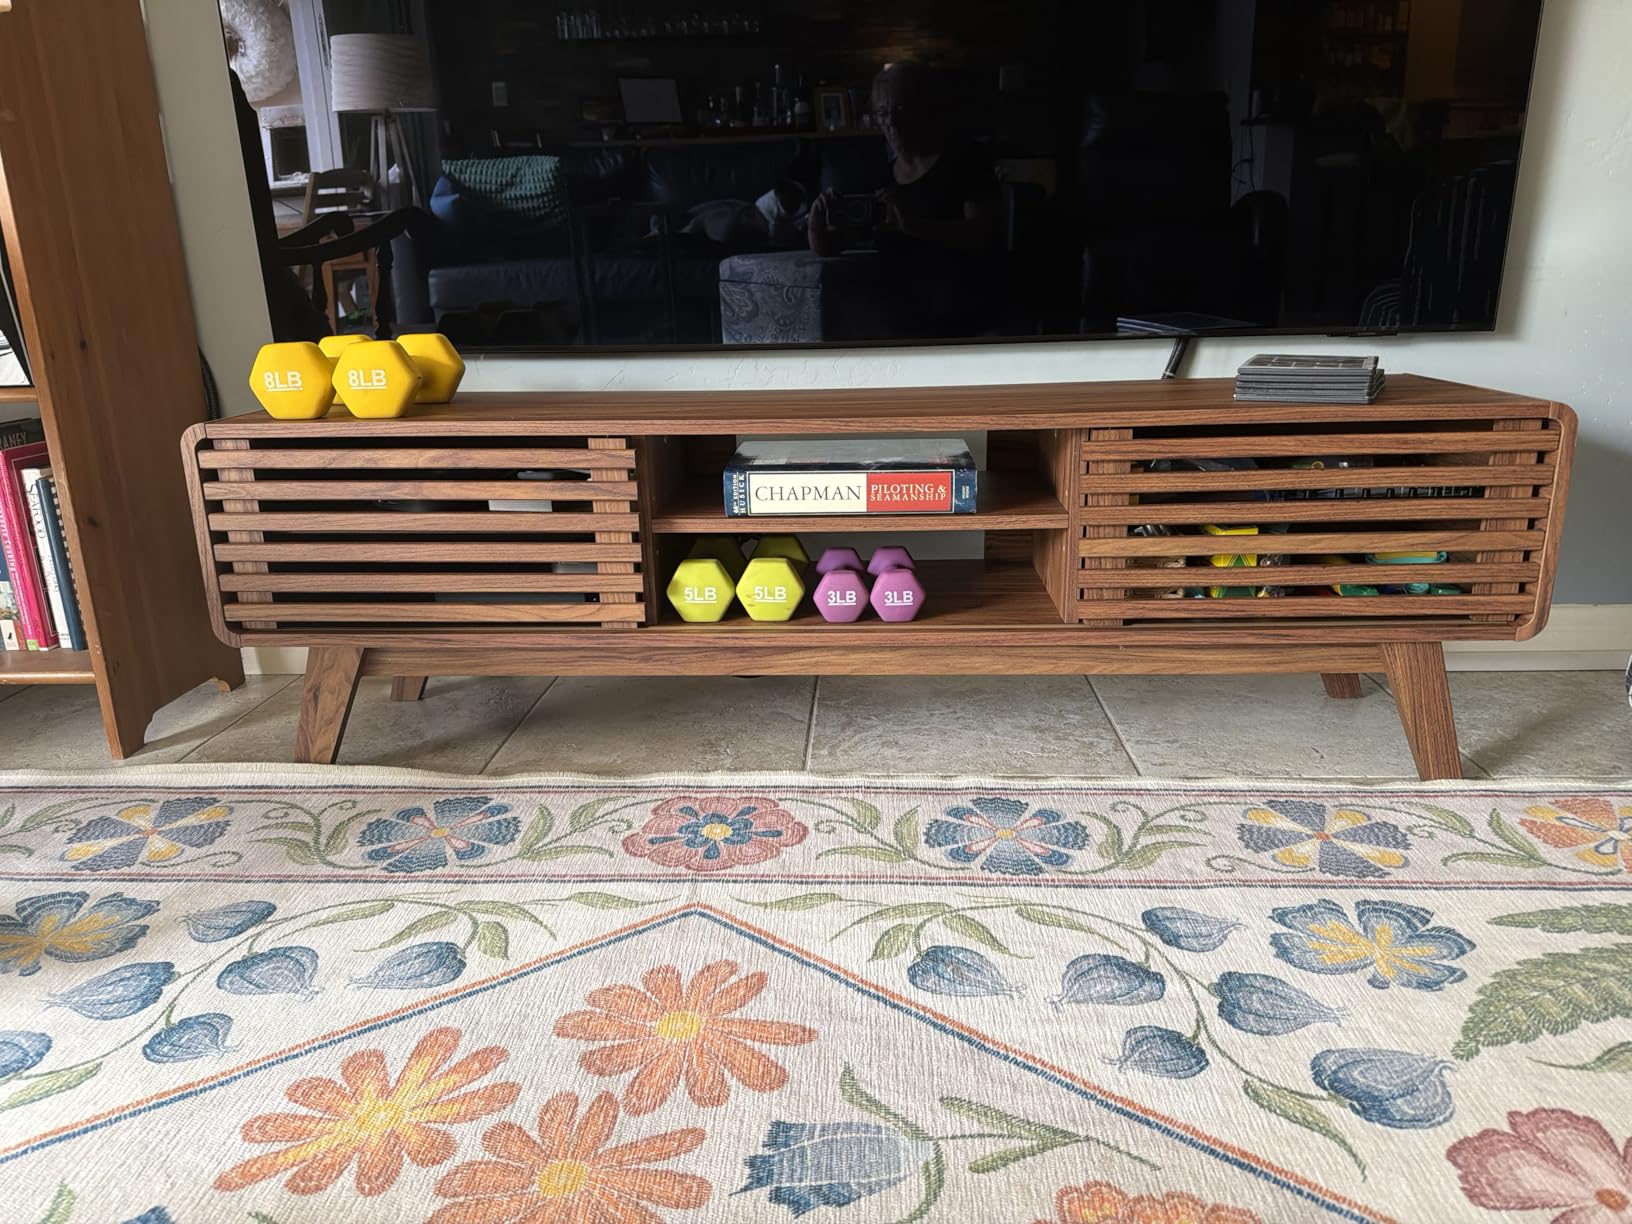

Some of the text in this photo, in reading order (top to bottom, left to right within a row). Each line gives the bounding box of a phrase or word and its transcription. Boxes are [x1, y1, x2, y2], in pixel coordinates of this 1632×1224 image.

[264, 371, 302, 389] 8LB
[348, 369, 387, 388] 8LB
[755, 485, 862, 502] CHAPMAN
[871, 484, 948, 494] PILOTING &
[870, 493, 948, 502] SEAMANSHIP
[684, 586, 717, 601] 5LB
[754, 585, 787, 601] 5LB
[827, 590, 857, 603] 3LB
[884, 590, 914, 603] 3LB
